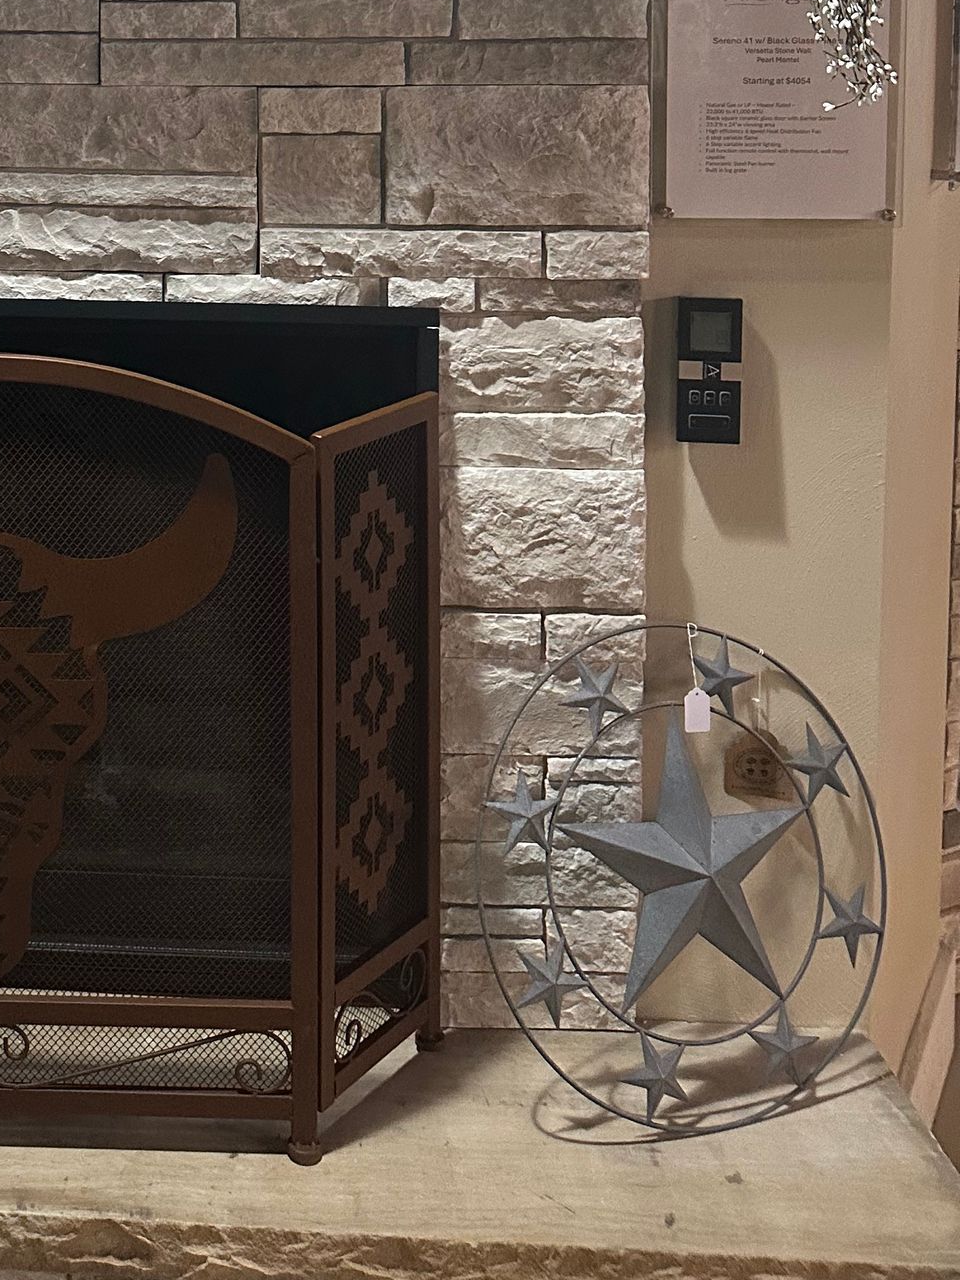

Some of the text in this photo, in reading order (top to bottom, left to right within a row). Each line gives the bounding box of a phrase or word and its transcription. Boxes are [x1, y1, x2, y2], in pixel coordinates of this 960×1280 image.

[712, 36, 742, 45] Sereno
[743, 36, 753, 45] 41
[767, 36, 789, 45] Black
[791, 36, 814, 45] Glass
[774, 46, 795, 55] Stone
[742, 76, 811, 87] Starting at $4054
